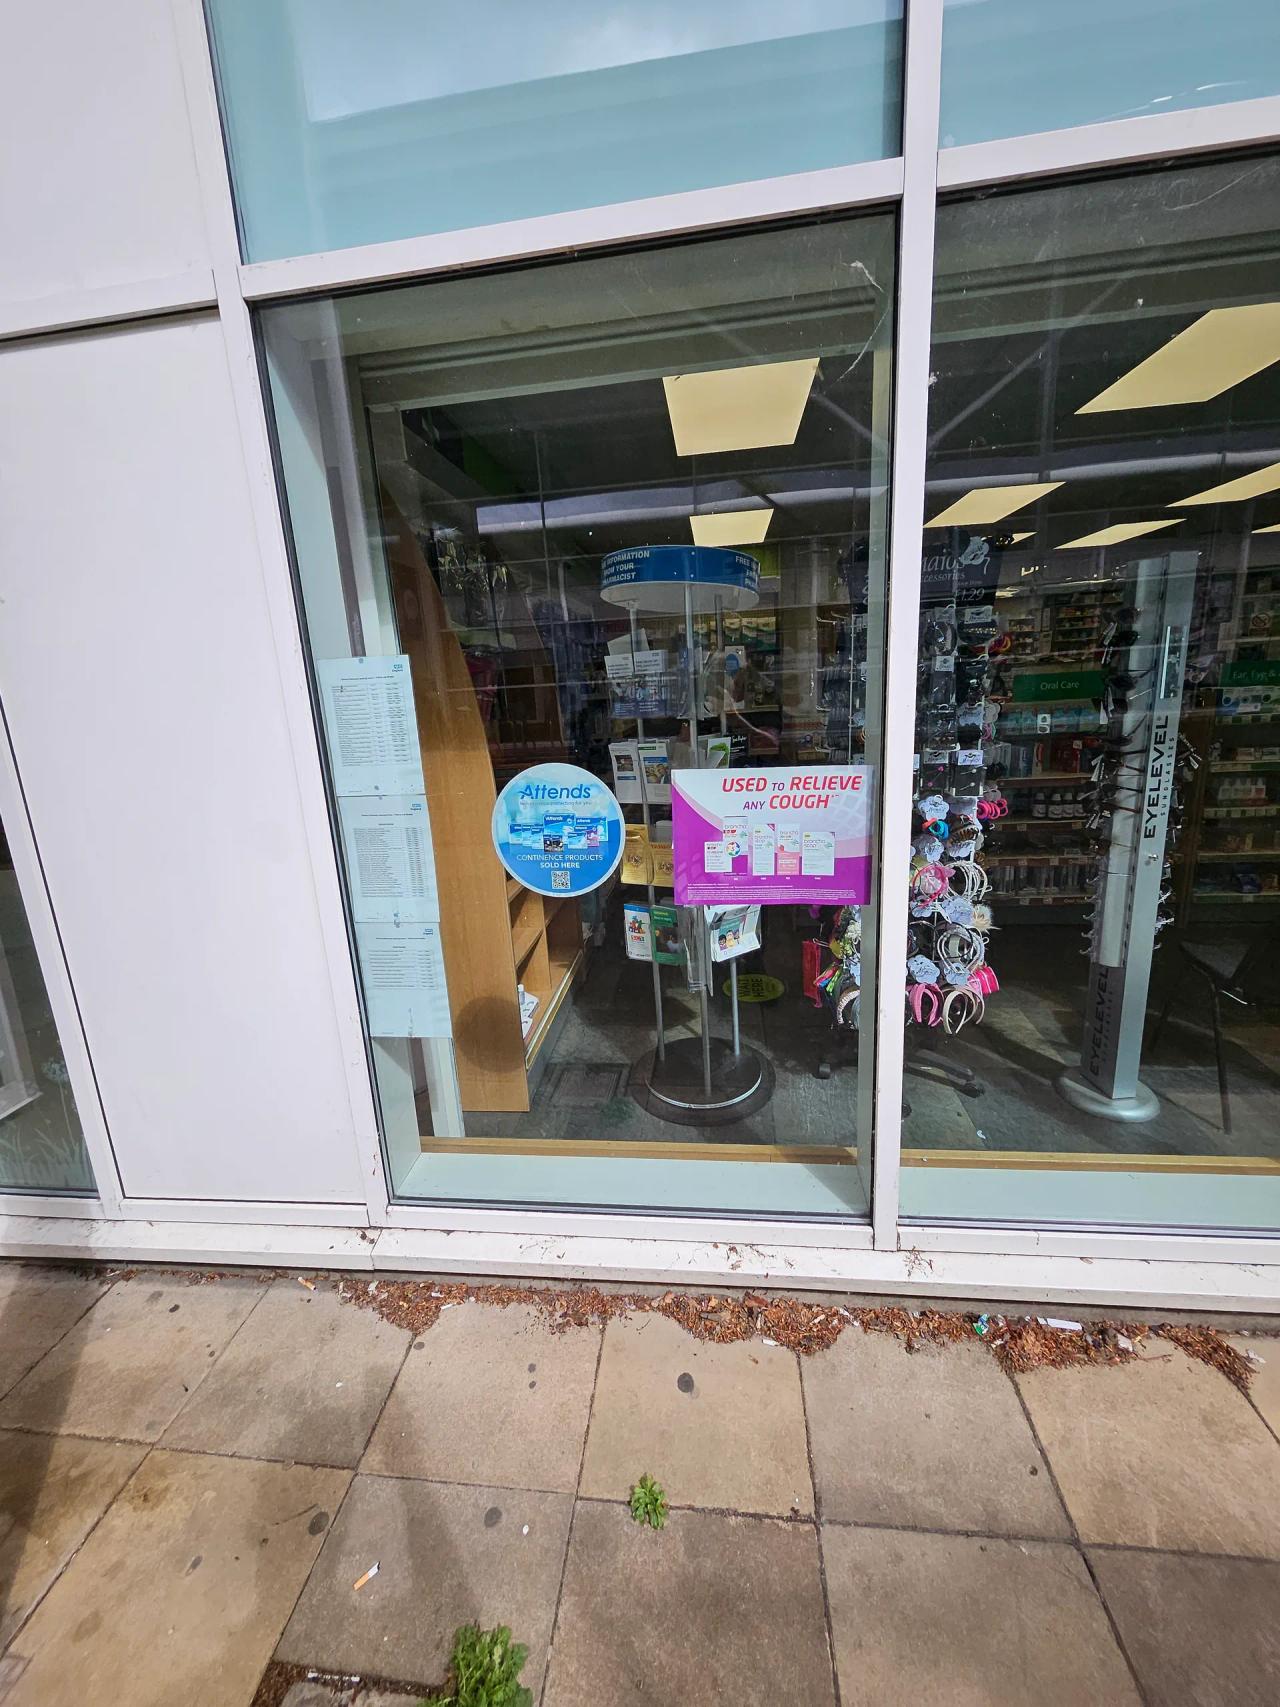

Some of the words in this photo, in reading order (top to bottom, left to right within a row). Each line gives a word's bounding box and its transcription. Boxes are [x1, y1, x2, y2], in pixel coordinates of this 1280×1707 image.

[616, 563, 634, 572] YOUR
[1040, 681, 1059, 691] Oral
[1060, 680, 1080, 690] Care
[1144, 715, 1169, 839] EYELEVEL
[722, 777, 768, 793] USED
[771, 782, 785, 791] TO
[789, 775, 863, 791] RELIEVE
[518, 784, 591, 800] Attends
[743, 800, 766, 810] ANY
